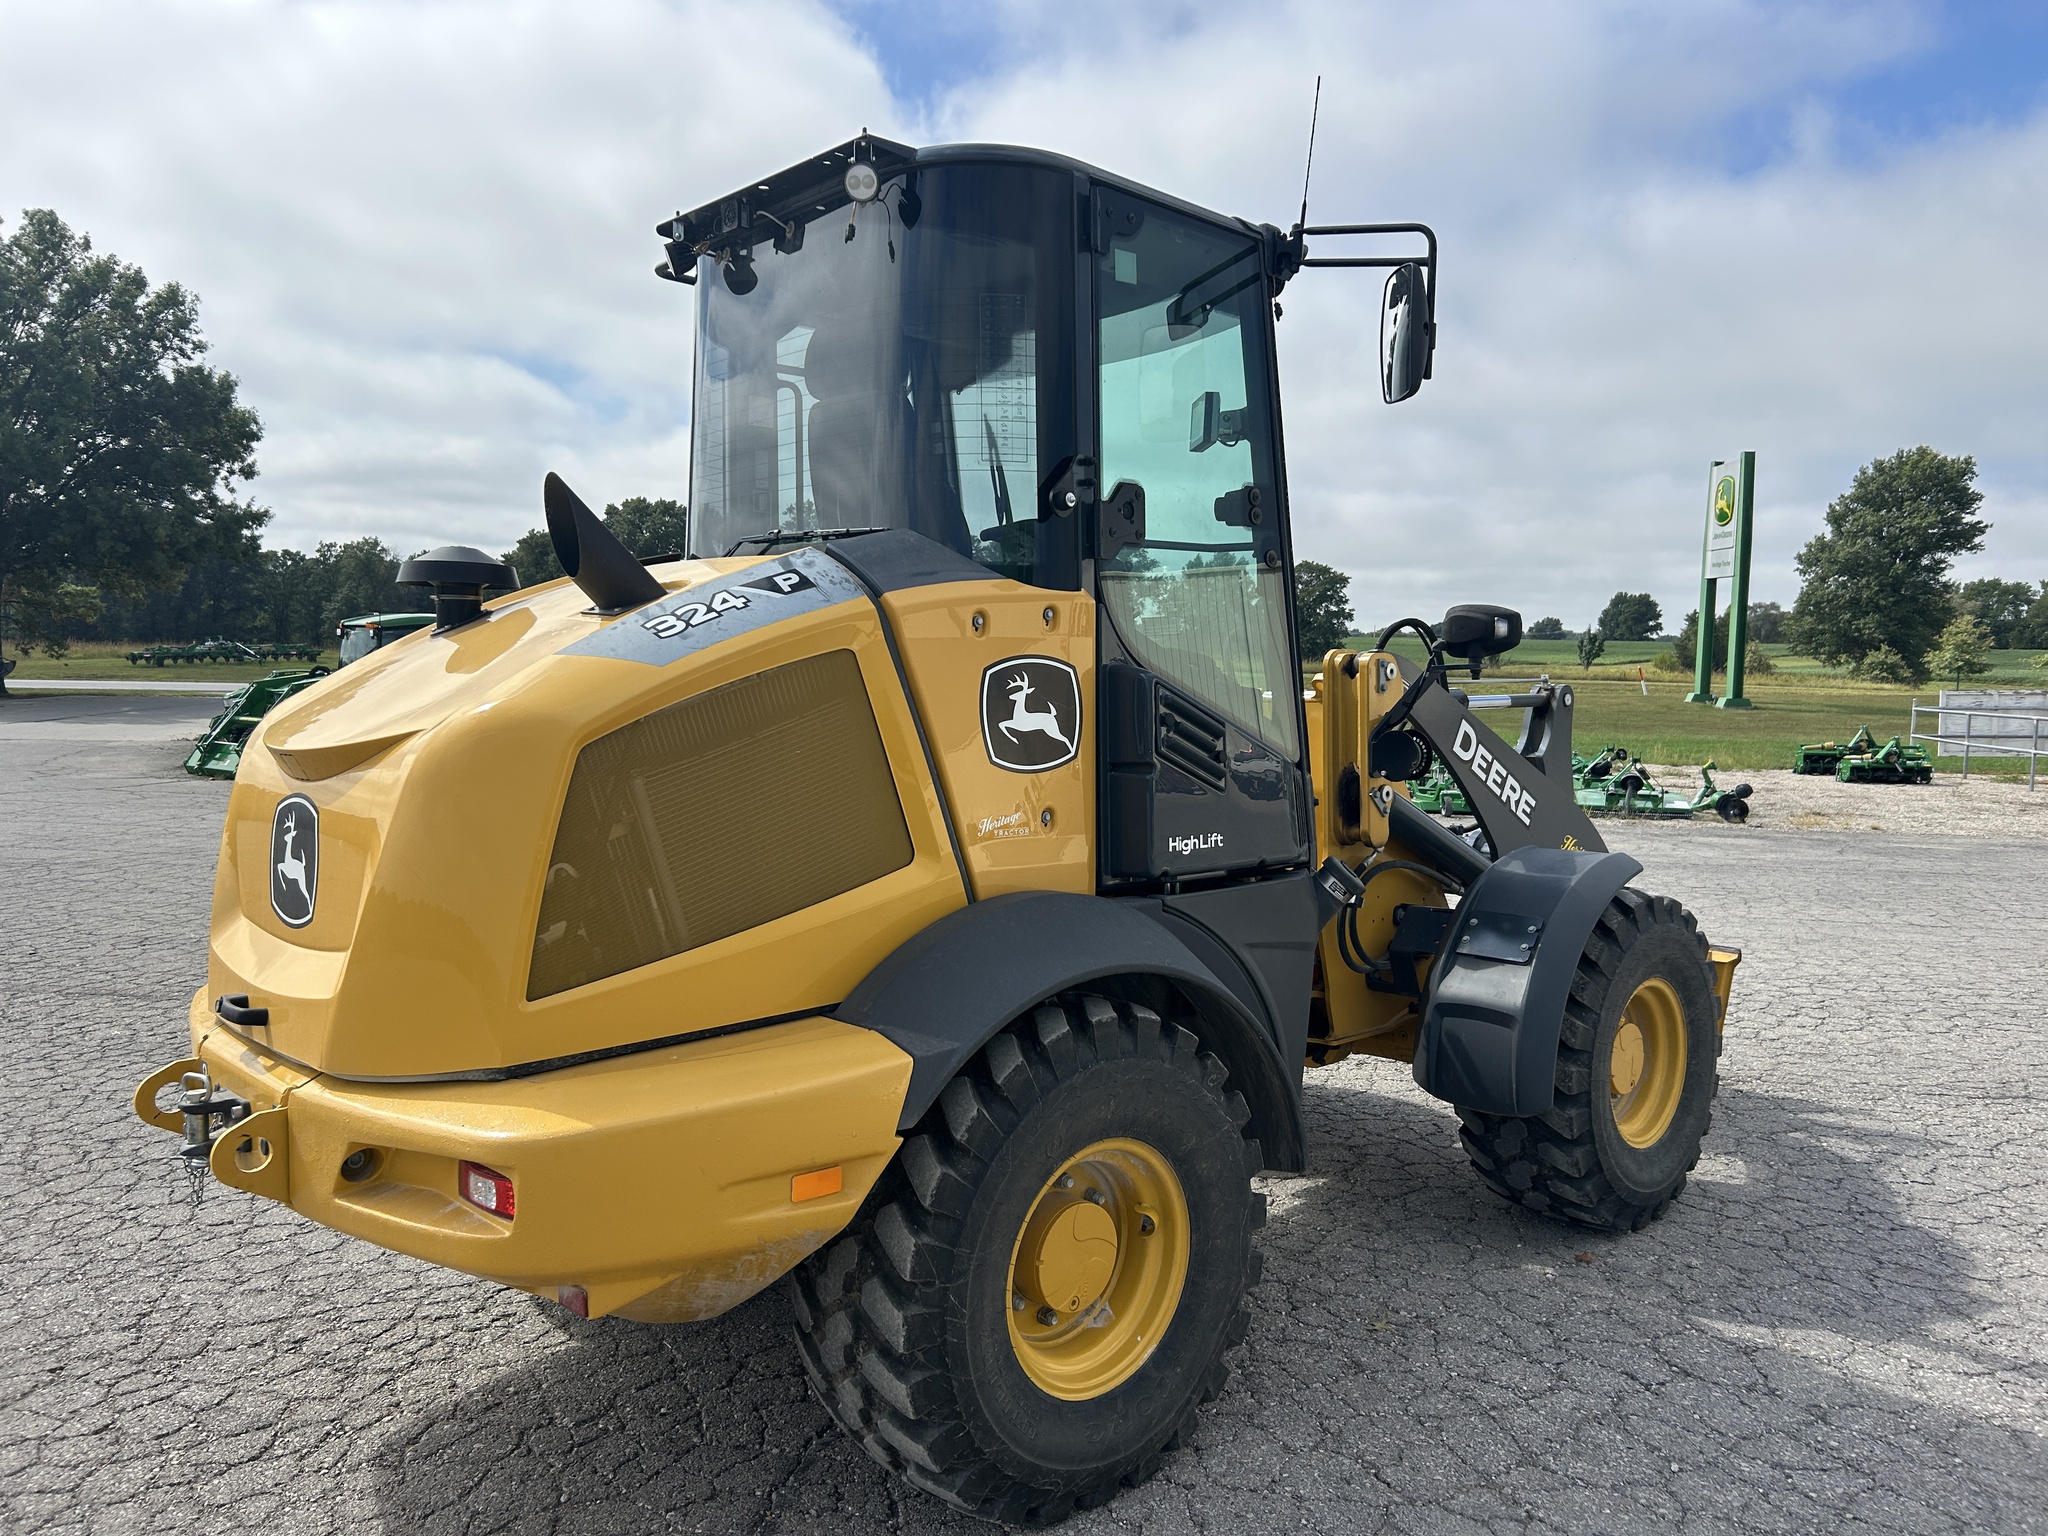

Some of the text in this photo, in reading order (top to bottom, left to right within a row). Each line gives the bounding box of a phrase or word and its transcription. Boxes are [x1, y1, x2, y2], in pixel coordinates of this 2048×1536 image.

[640, 572, 800, 639] 324 P
[1453, 718, 1536, 826] DEERE
[978, 811, 1022, 837] Heritage
[994, 828, 1029, 836] TRACTOR
